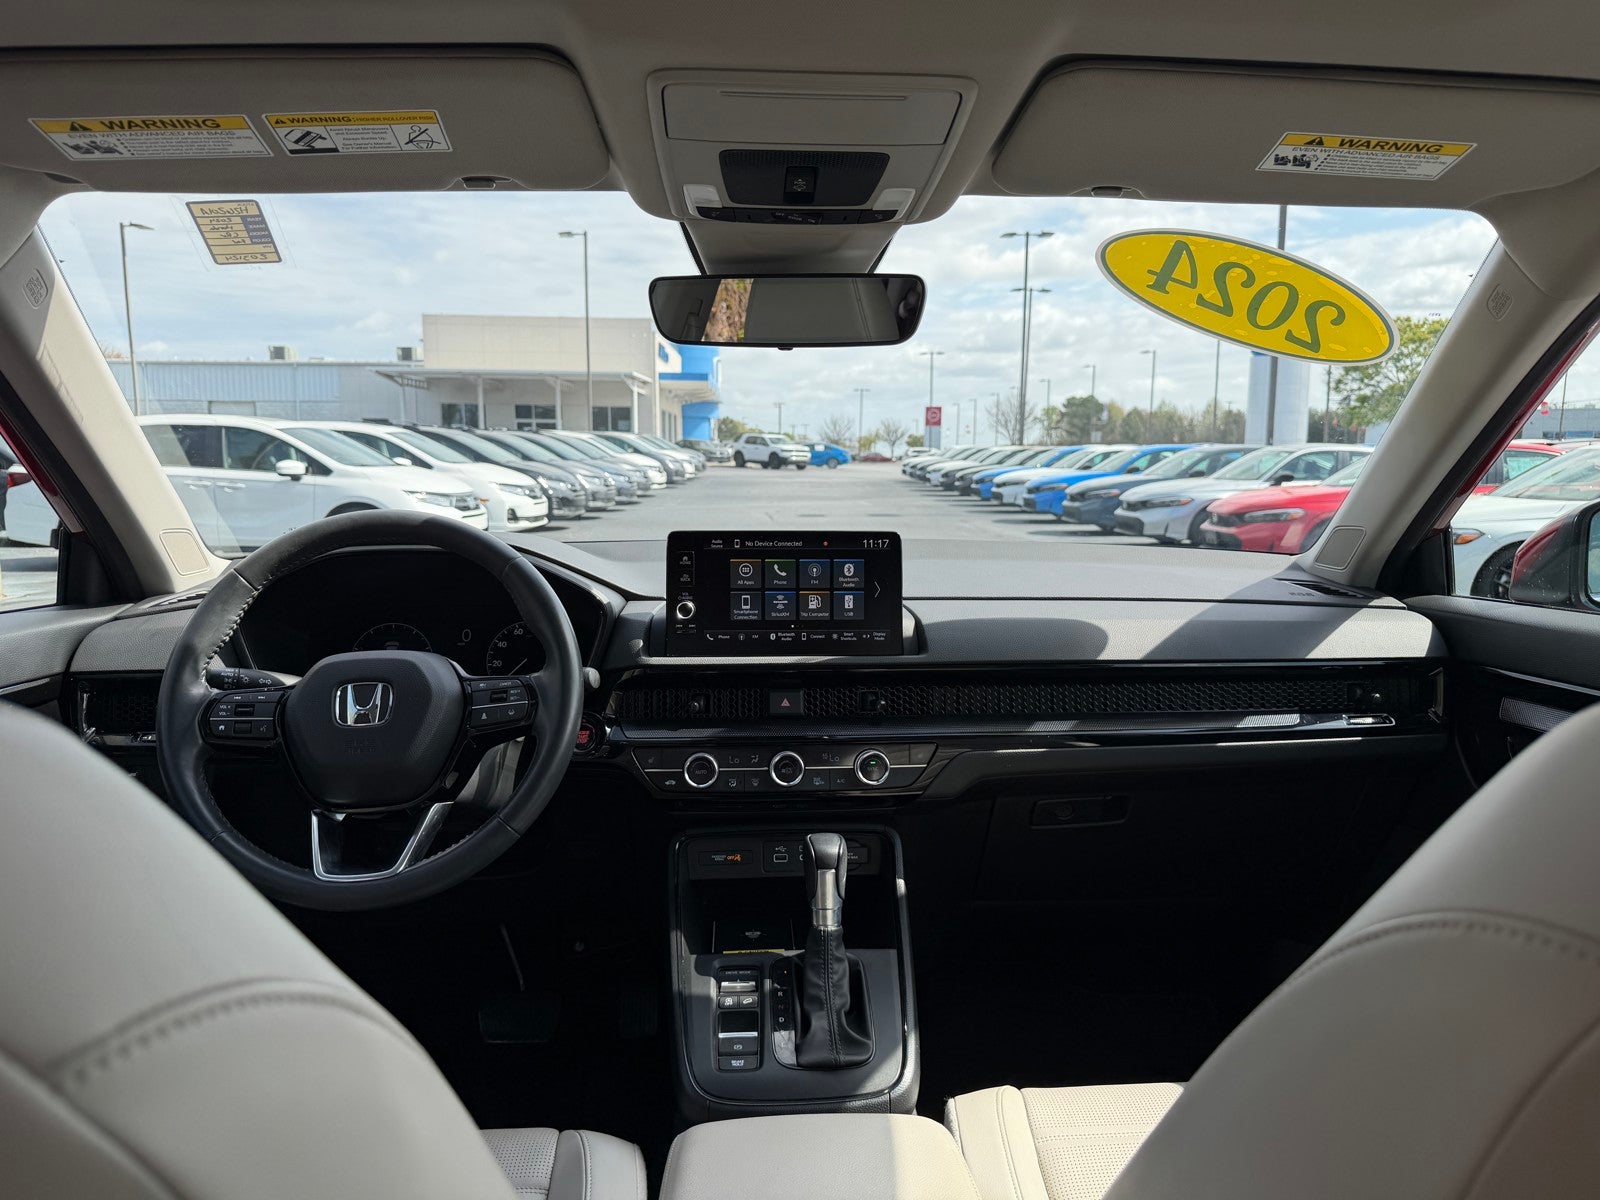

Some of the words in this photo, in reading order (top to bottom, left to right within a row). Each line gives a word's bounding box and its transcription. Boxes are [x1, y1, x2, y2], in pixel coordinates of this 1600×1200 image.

[100, 119, 221, 130] WARNING
[1339, 138, 1444, 153] WARNING
[1344, 150, 1395, 158] ADVANCED
[863, 539, 889, 548] 11:17
[462, 629, 471, 642] 0
